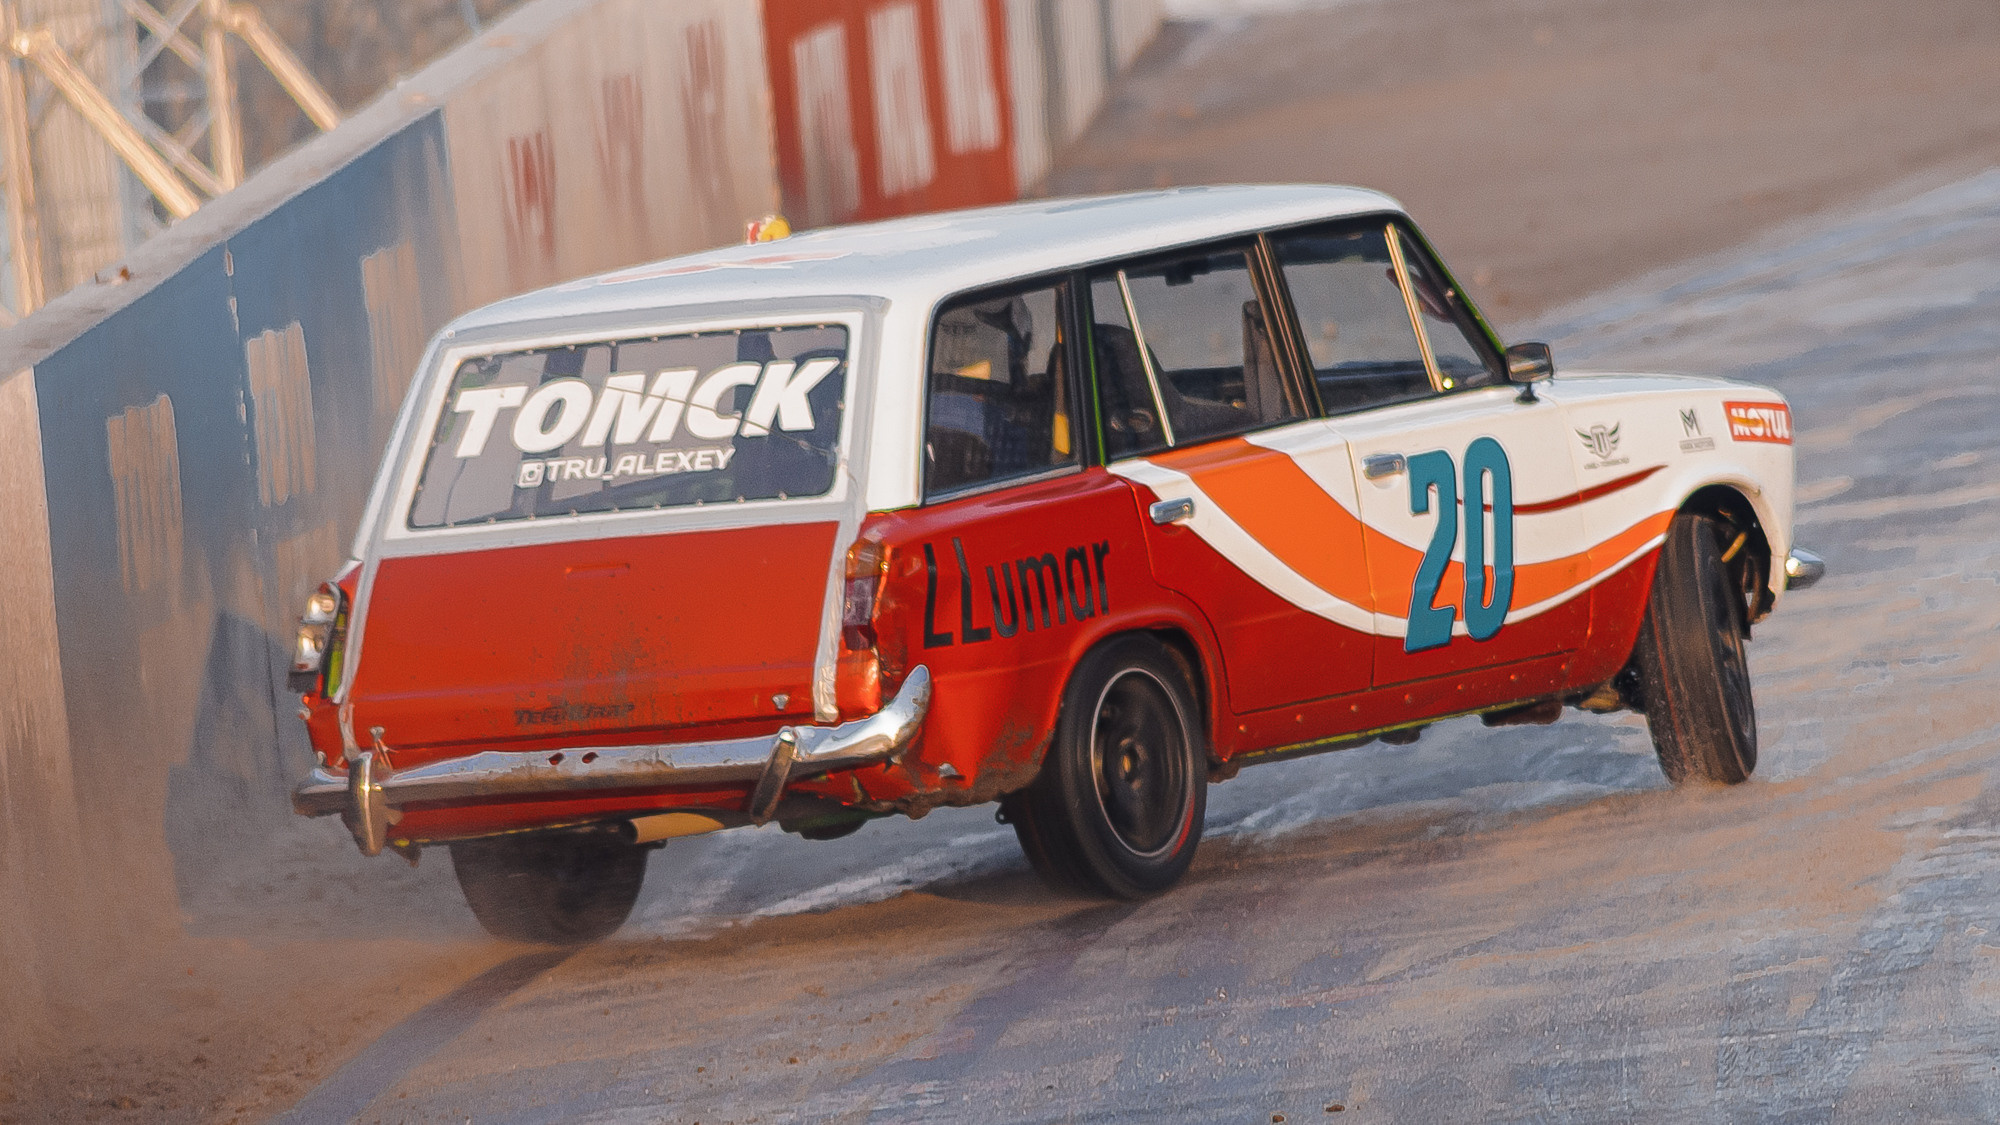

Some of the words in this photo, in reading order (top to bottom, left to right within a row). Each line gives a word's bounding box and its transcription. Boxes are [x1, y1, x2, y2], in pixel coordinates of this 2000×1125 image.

[455, 357, 841, 458] TOMCK
[1730, 407, 1790, 439] MOTUL
[546, 447, 736, 481] TRU_ALEXEY
[923, 537, 1110, 649] LLumar
[1404, 436, 1514, 654] 20
